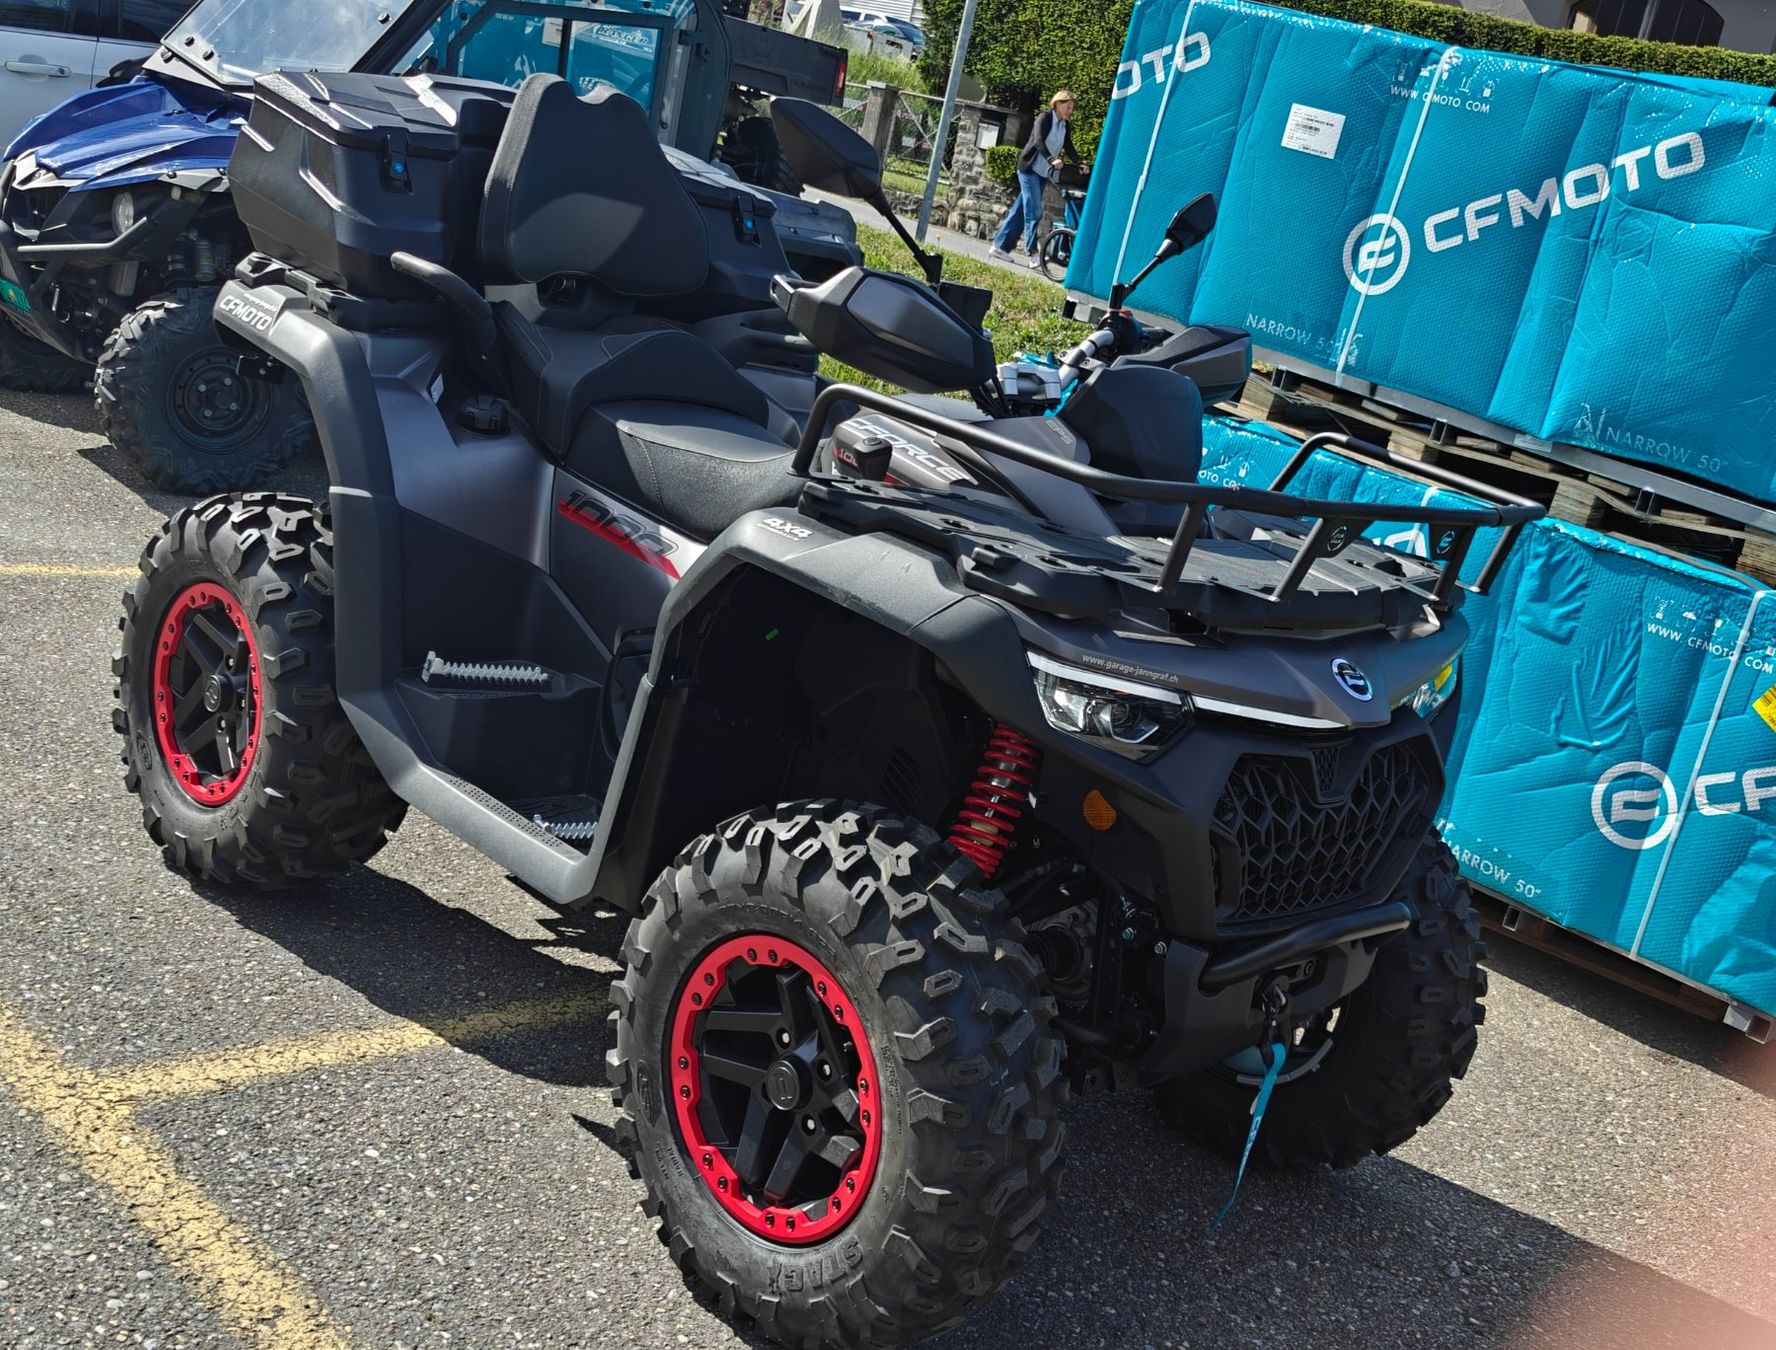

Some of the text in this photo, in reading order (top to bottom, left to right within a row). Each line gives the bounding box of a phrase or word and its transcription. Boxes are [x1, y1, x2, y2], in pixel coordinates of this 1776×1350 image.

[1423, 131, 1706, 253] CFMOTO
[219, 294, 273, 331] CFMOTO
[1246, 313, 1312, 345] NARROW
[1605, 426, 1691, 464] NARROW
[562, 490, 679, 564] 1000
[1082, 655, 1179, 683] www.garage-janngraf.ch
